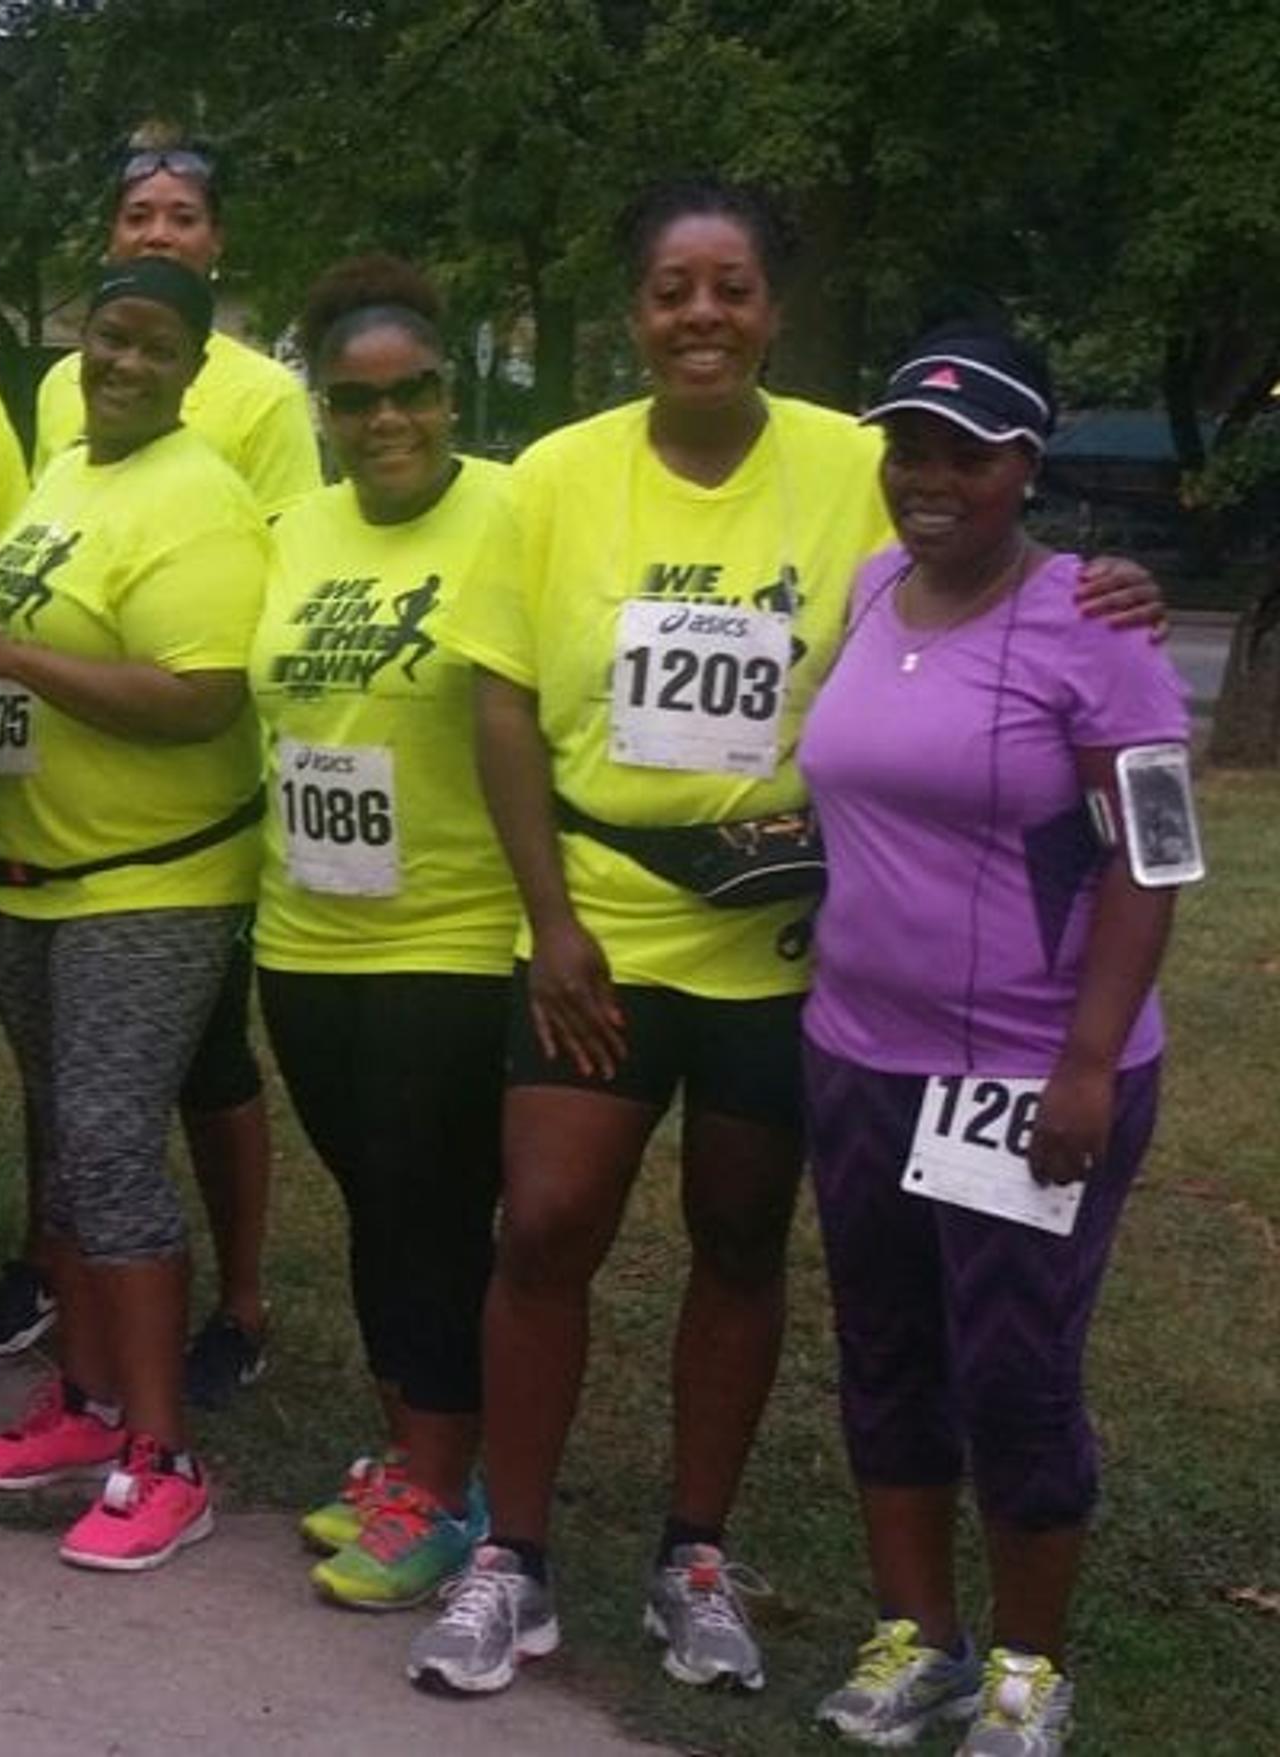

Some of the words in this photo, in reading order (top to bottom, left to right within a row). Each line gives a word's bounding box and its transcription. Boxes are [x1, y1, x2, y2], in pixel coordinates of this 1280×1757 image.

[310, 579, 381, 600] WE
[645, 563, 723, 594] WE
[290, 599, 382, 625] RUN
[689, 615, 749, 637] asics
[624, 645, 781, 721] 1203
[282, 781, 391, 846] 1086
